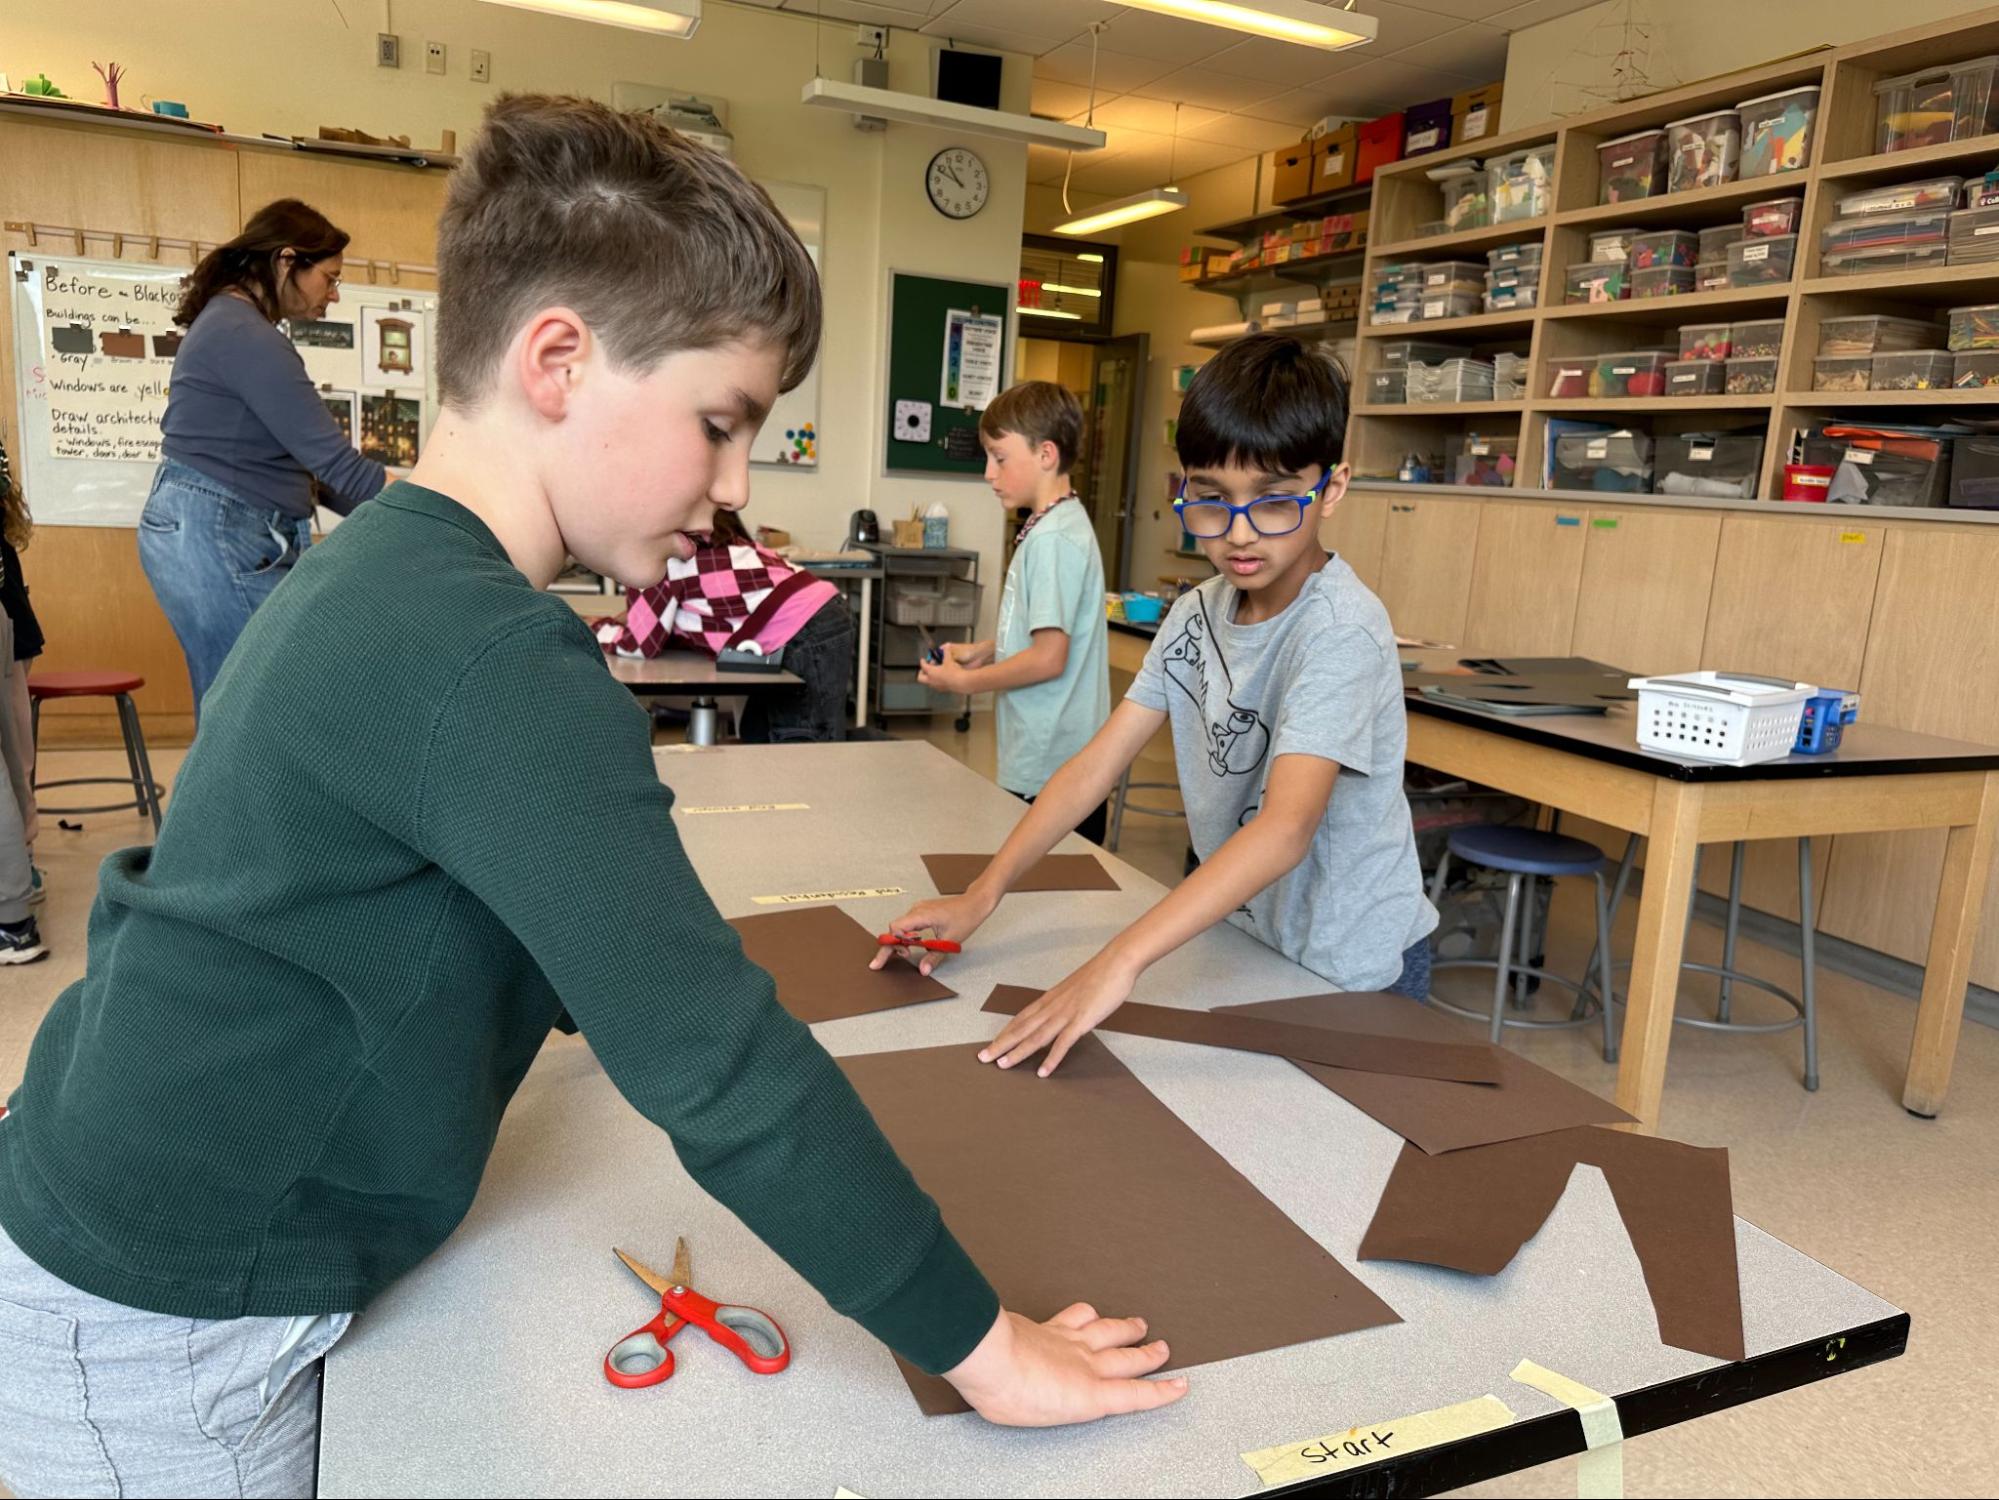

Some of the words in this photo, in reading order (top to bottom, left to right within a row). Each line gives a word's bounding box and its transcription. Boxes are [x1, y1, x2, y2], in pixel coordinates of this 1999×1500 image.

[46, 275, 113, 299] Before
[133, 284, 181, 301] Blacko
[46, 308, 96, 329] Buildings
[102, 313, 120, 324] can
[60, 352, 88, 372] Gray
[49, 379, 105, 393] Windows
[109, 384, 128, 393] are
[51, 408, 88, 422] Draw
[1300, 1431, 1394, 1463] Start
